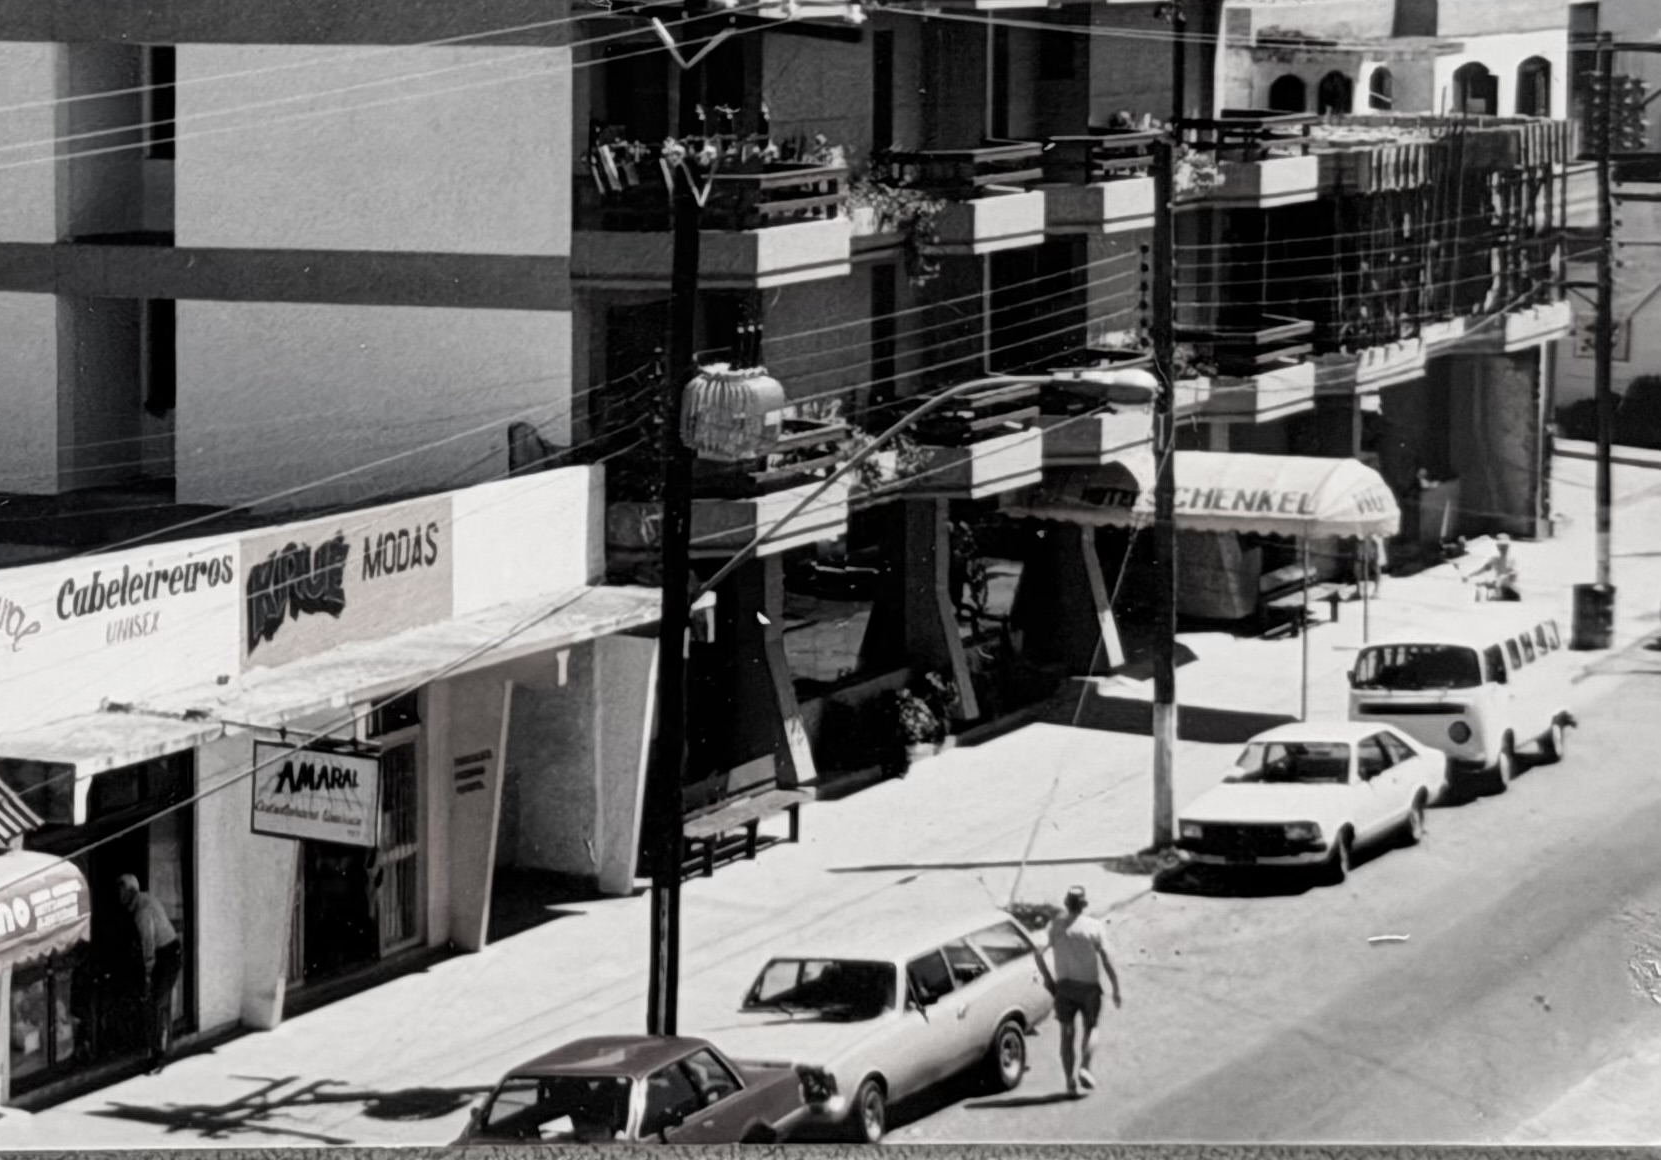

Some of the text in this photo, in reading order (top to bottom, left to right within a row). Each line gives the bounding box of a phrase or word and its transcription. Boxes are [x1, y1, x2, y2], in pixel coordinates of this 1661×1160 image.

[361, 521, 439, 582] MODAS
[56, 552, 234, 620] Cabeleireiros
[106, 611, 161, 645] UNISEX
[274, 760, 360, 794] AMARAL
